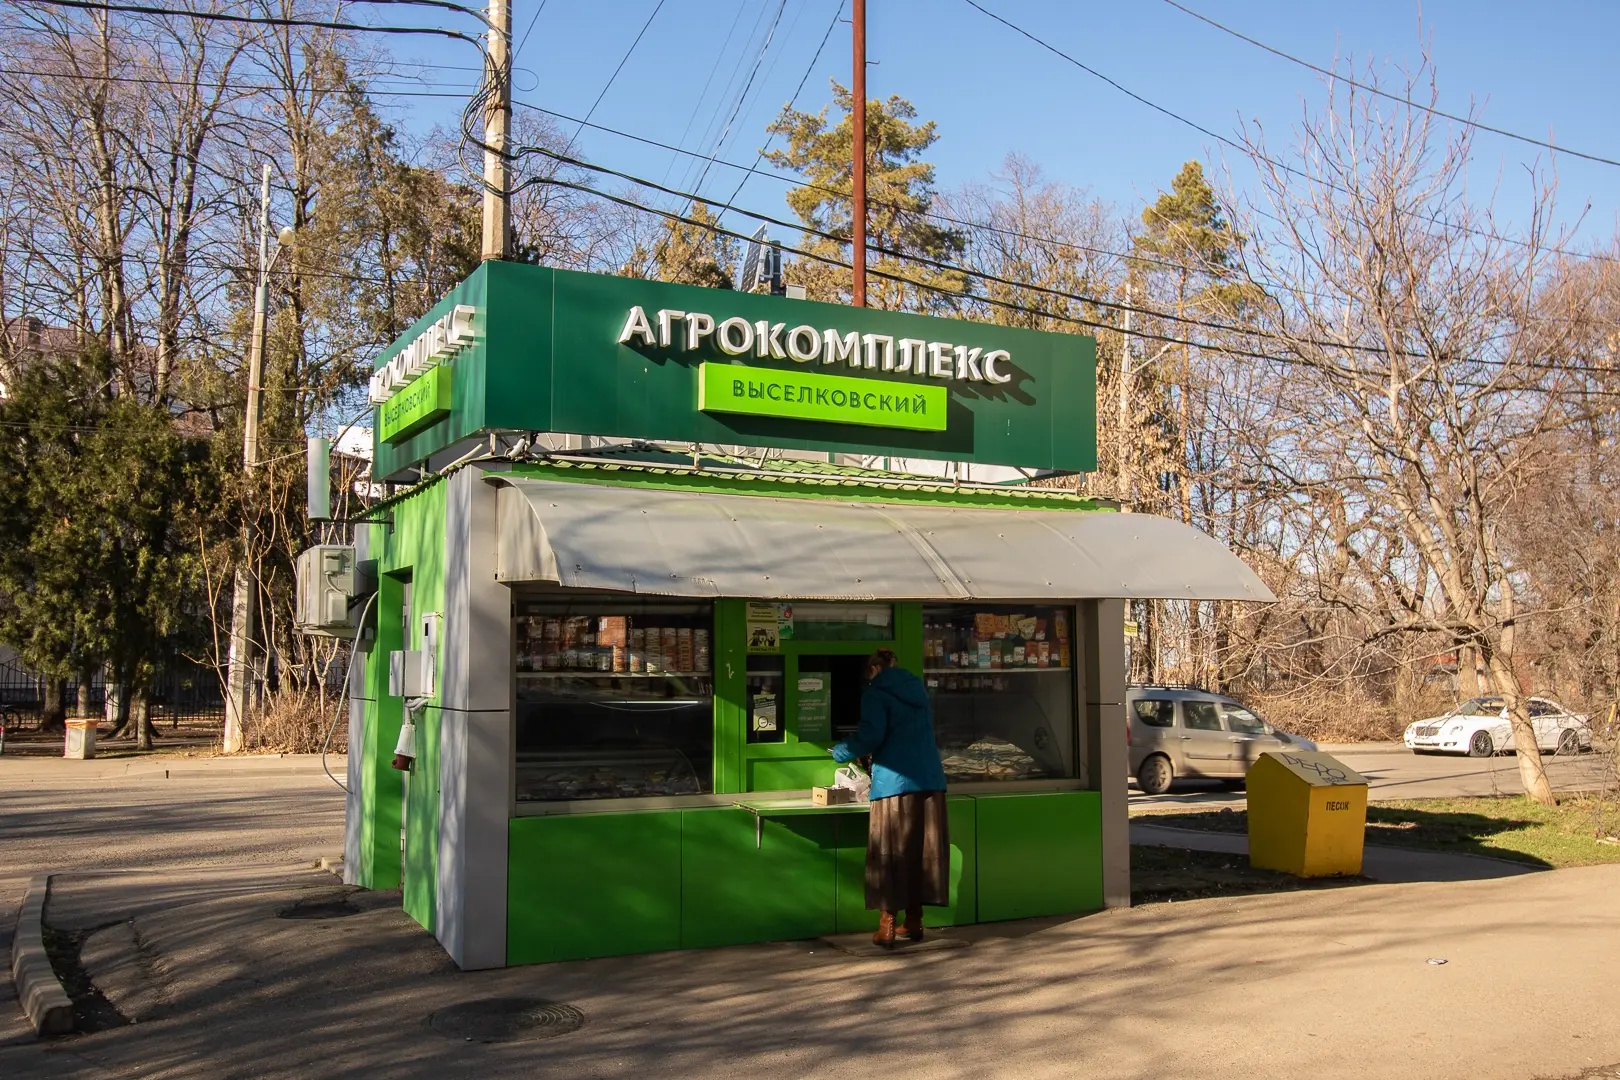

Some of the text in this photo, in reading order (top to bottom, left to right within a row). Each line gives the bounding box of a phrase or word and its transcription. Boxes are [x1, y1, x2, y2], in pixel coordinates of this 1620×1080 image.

[617, 306, 1012, 384] АГРОКОМПЛЕКС
[733, 379, 927, 415] ВЫСЕЛКОВСКИЙ
[1326, 801, 1350, 811] ПЕСОК
